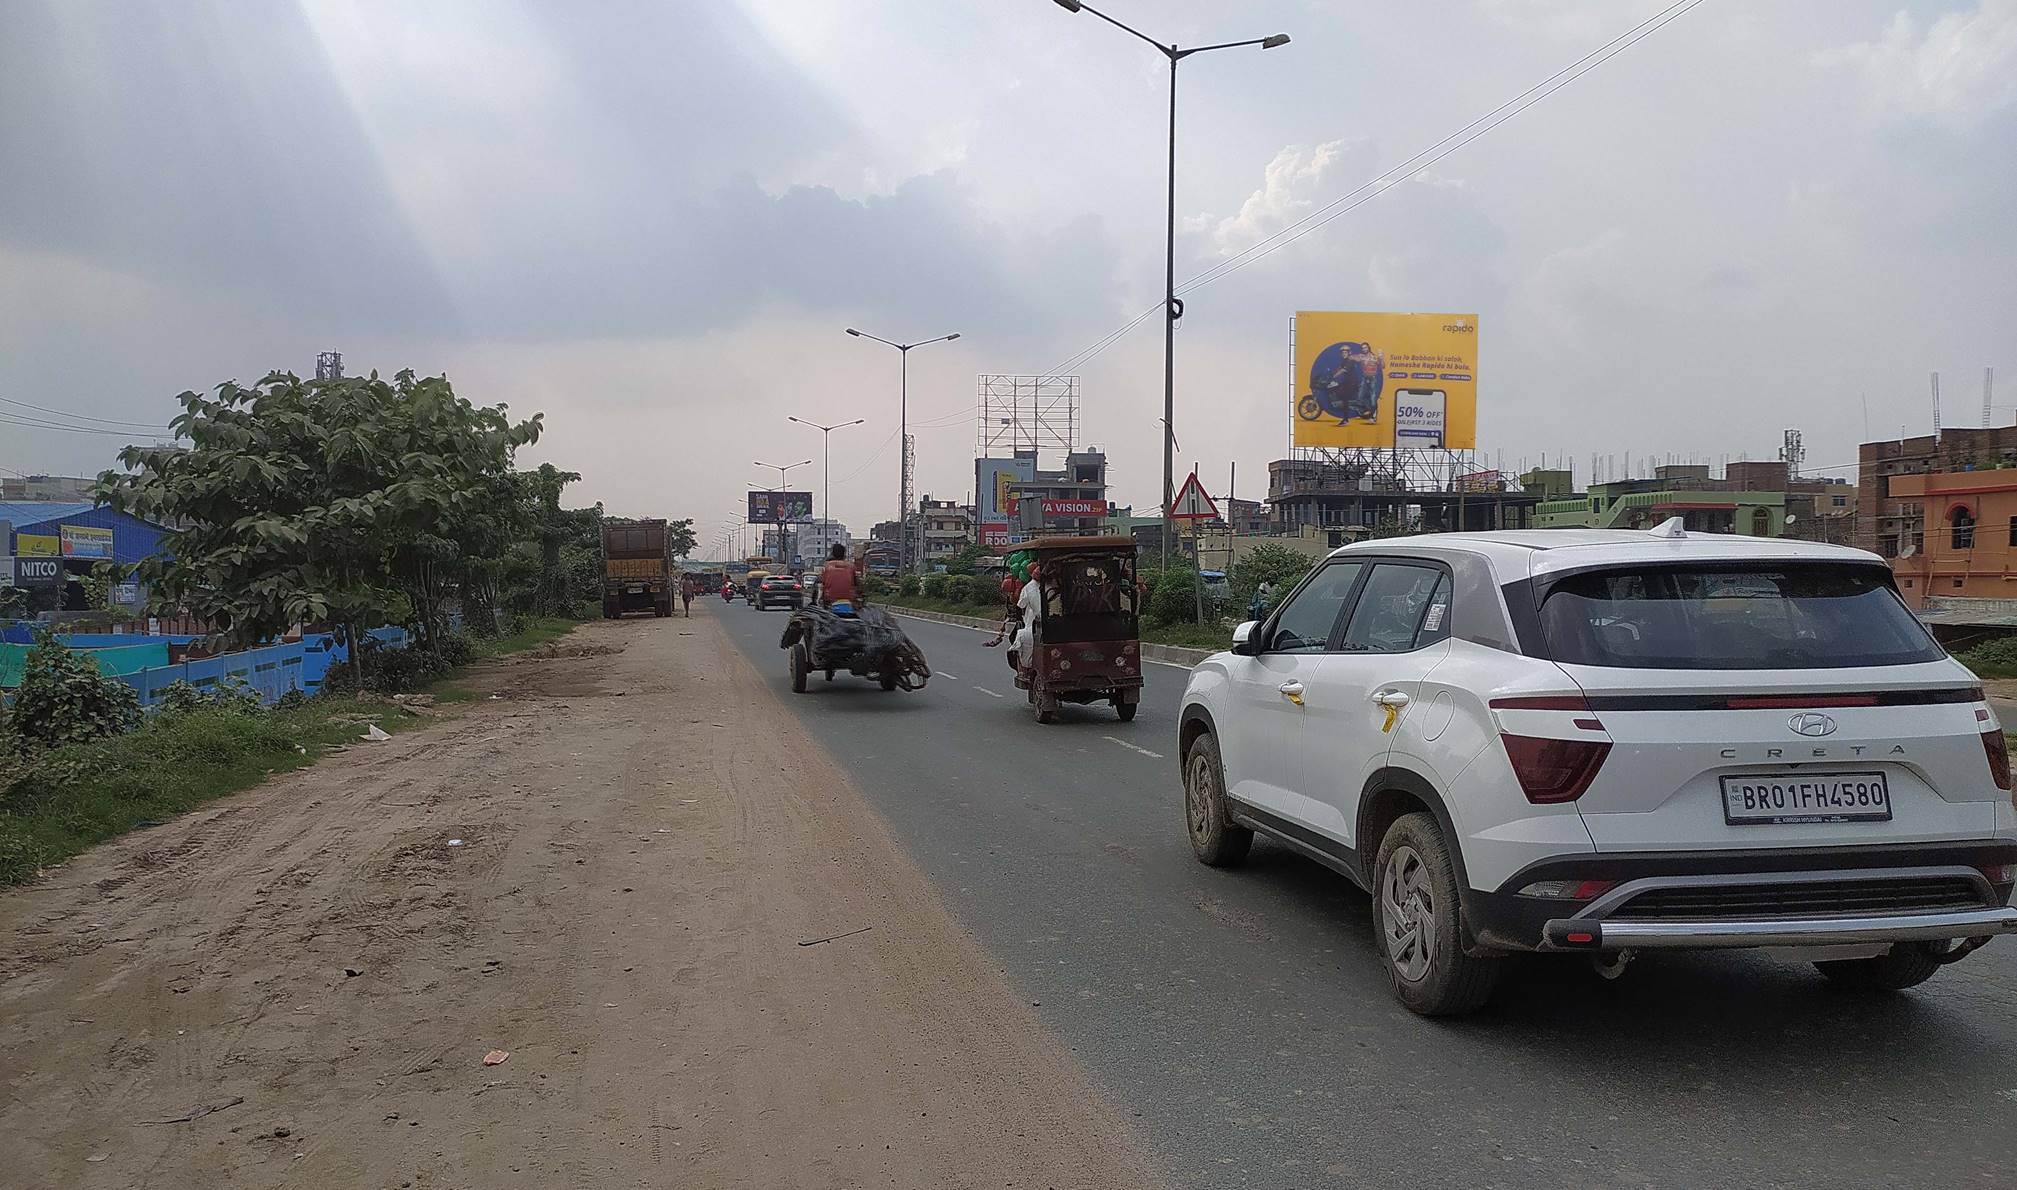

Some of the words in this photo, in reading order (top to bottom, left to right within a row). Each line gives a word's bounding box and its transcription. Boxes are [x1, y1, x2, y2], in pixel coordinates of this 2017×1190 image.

[1443, 324, 1474, 334] rapido
[1397, 406, 1424, 418] 50%
[1056, 503, 1091, 512] VISION
[21, 561, 57, 577] NITCO
[1720, 744, 1906, 759] CRETA
[1742, 782, 1884, 810] BR01FH4580
